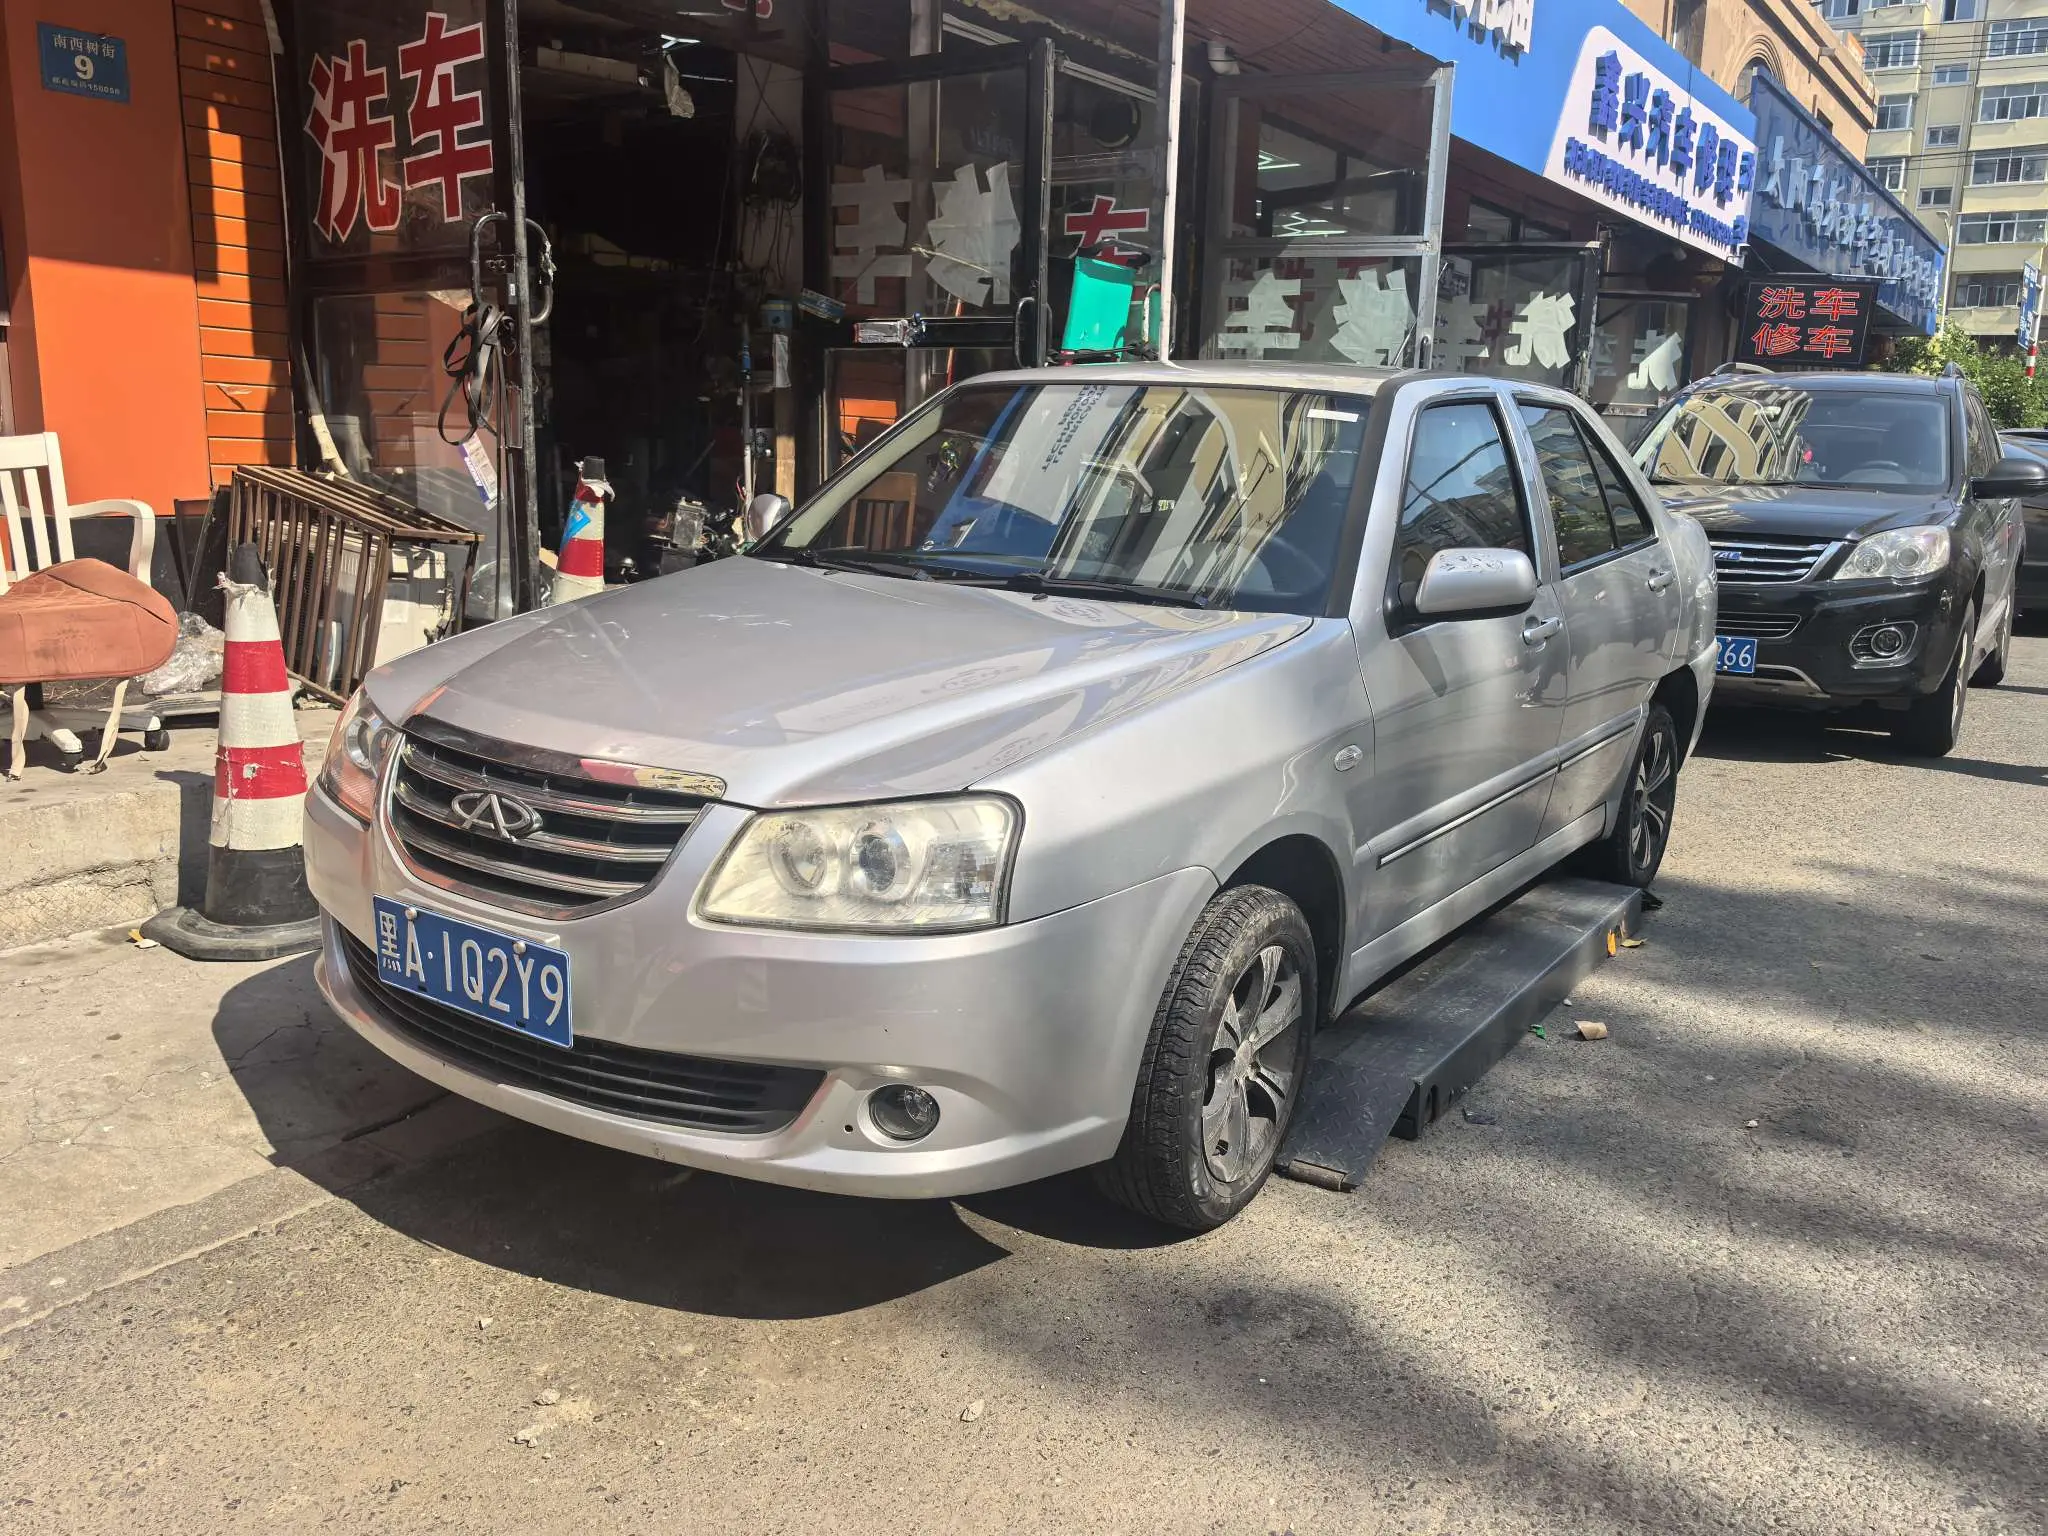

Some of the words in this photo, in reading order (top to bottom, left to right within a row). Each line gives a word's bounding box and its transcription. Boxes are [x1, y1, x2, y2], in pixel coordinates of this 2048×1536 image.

[74, 55, 94, 80] 9
[303, 12, 494, 243] 洗车
[1757, 286, 1860, 322] 洗车
[1751, 322, 1854, 358] 修车
